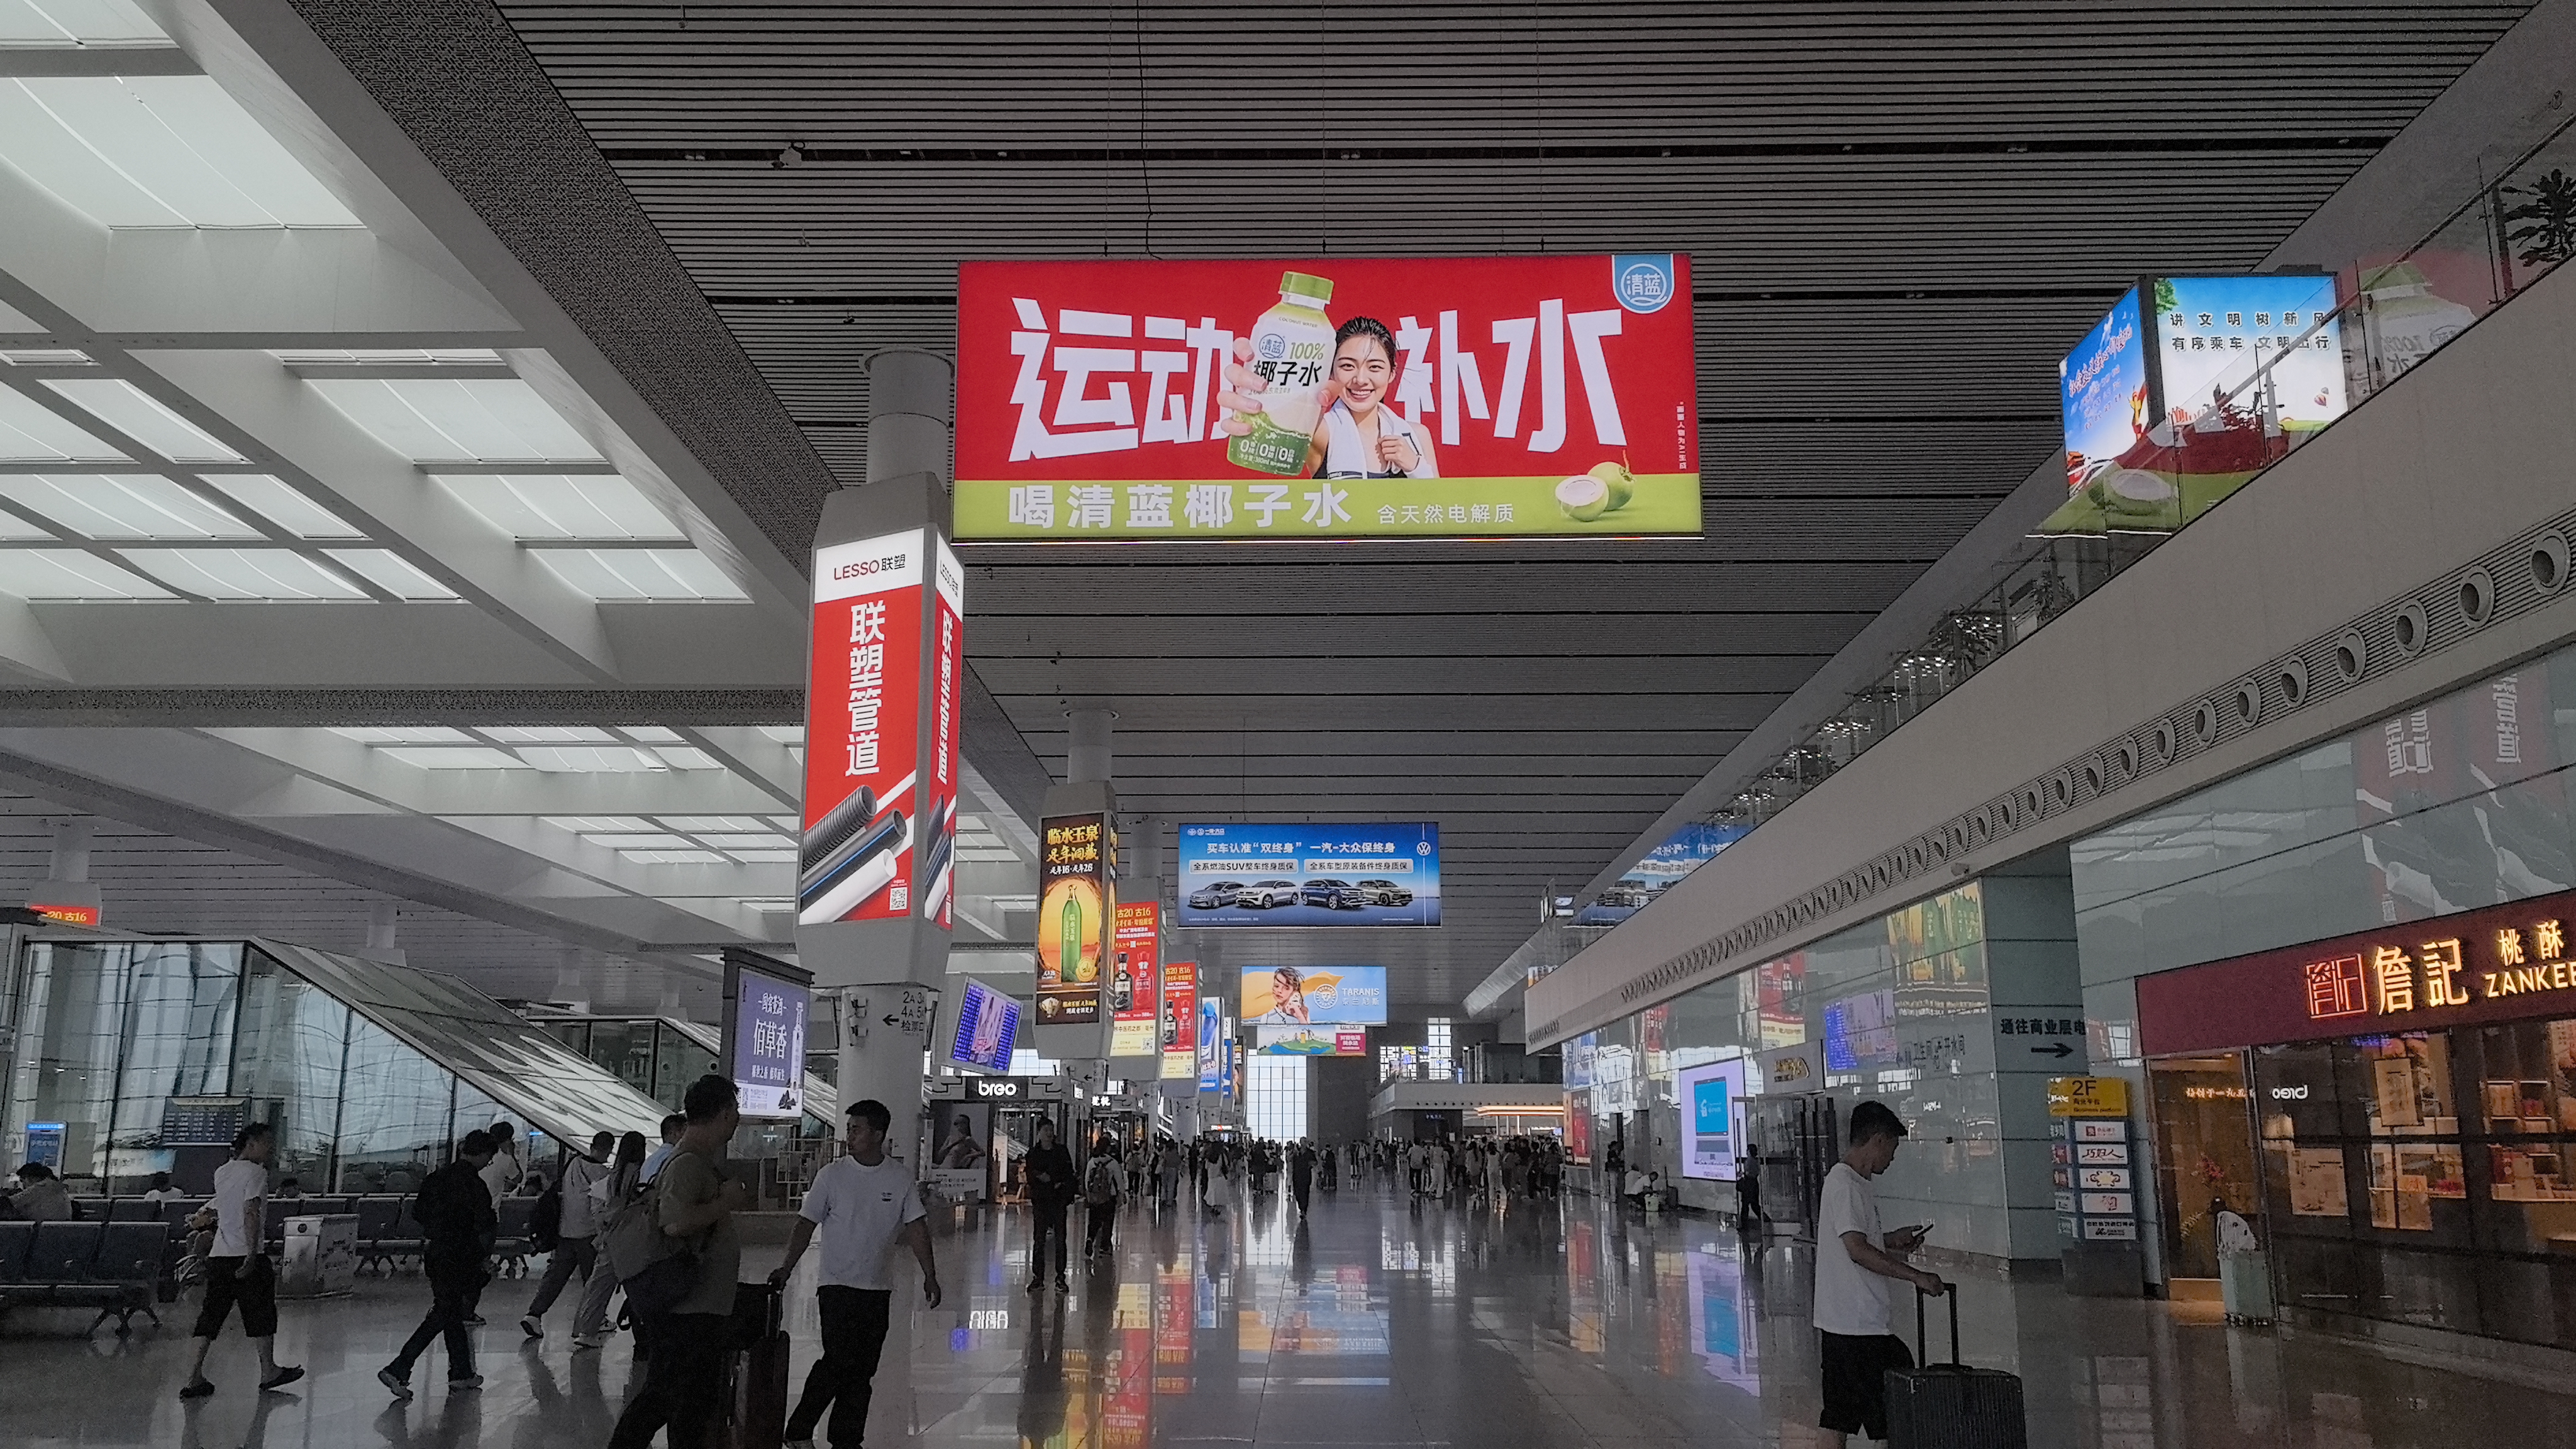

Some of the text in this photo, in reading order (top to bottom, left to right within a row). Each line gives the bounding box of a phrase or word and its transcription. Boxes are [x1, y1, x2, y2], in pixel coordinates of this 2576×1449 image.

[1627, 272, 1662, 296] 清蓝
[2169, 313, 2328, 327] 讲文明树新风
[1290, 341, 1325, 360] 100%
[2172, 335, 2331, 350] 有序乘车 文明出行
[1009, 297, 1628, 462] 运动 补水
[1253, 360, 1322, 387] 椰子水
[1009, 484, 1352, 530] 喝清蓝椰子水
[1377, 502, 1515, 525] 含天然电解质
[845, 600, 886, 777] 联塑管道
[1047, 825, 1099, 845] 临水玉泉
[1194, 862, 1294, 871] 全系燃油SUV整车终身质保
[65, 912, 87, 922] 古16
[1135, 906, 1152, 917] 古16
[2499, 919, 2564, 966] 桃酥
[1341, 987, 1380, 996] TARANIS
[901, 1020, 924, 1032] 检票口
[753, 1018, 787, 1060] 佰草香
[979, 1080, 1016, 1096] breo
[2072, 1080, 2097, 1096] 2F
